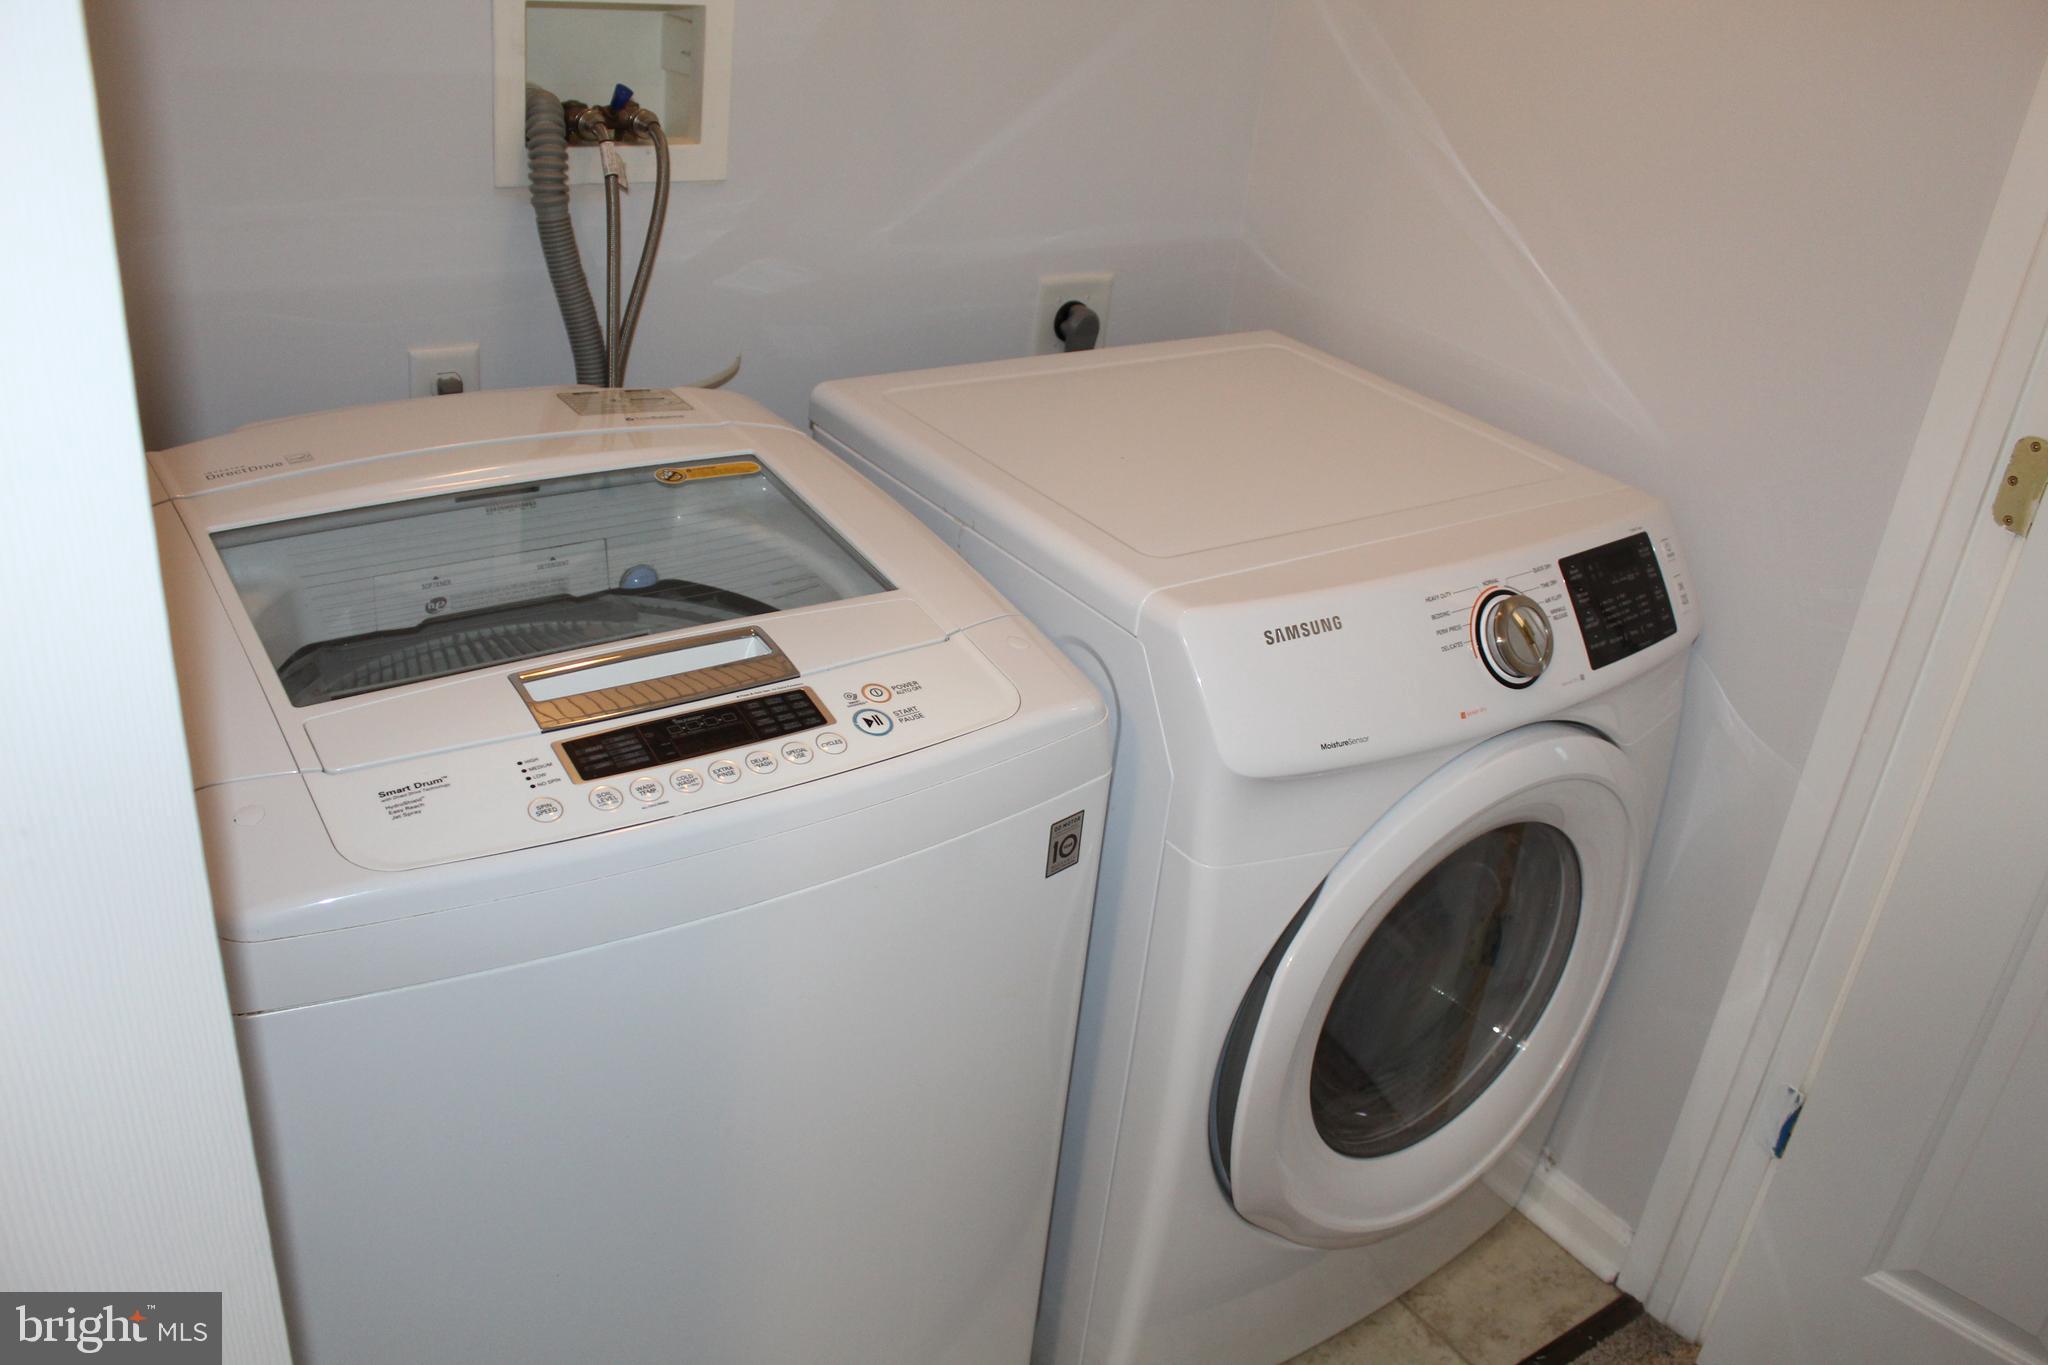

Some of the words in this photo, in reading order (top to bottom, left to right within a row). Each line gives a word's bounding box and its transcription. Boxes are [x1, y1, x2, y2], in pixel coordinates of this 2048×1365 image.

[1263, 615, 1343, 645] SAMSUNG
[891, 680, 920, 690] POWER
[893, 706, 919, 717] START
[898, 713, 925, 724] PAUSE
[712, 766, 735, 775] EXTRA
[378, 785, 412, 798] Smart
[635, 783, 656, 792] WASH
[596, 794, 618, 803] LEVEL
[535, 806, 558, 817] SPEED
